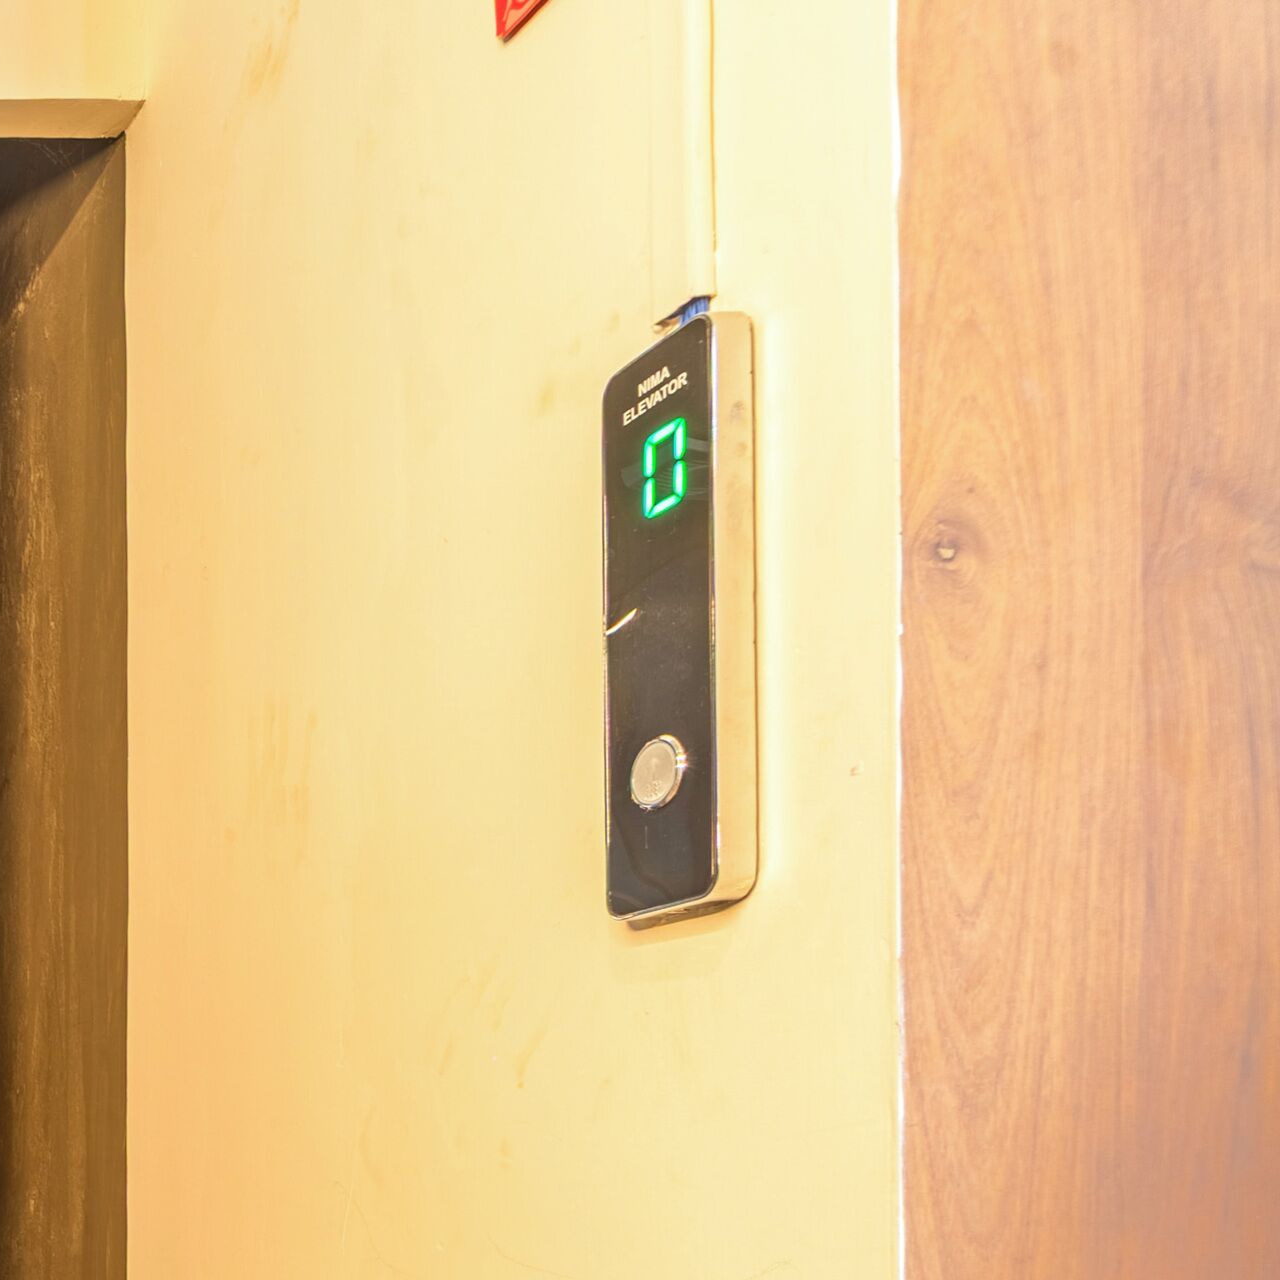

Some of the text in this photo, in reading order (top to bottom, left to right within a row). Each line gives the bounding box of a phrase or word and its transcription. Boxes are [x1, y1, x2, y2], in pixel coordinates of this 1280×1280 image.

[623, 372, 688, 426] ELEVATOR
[637, 366, 670, 398] NIMA
[643, 417, 687, 518] 0
